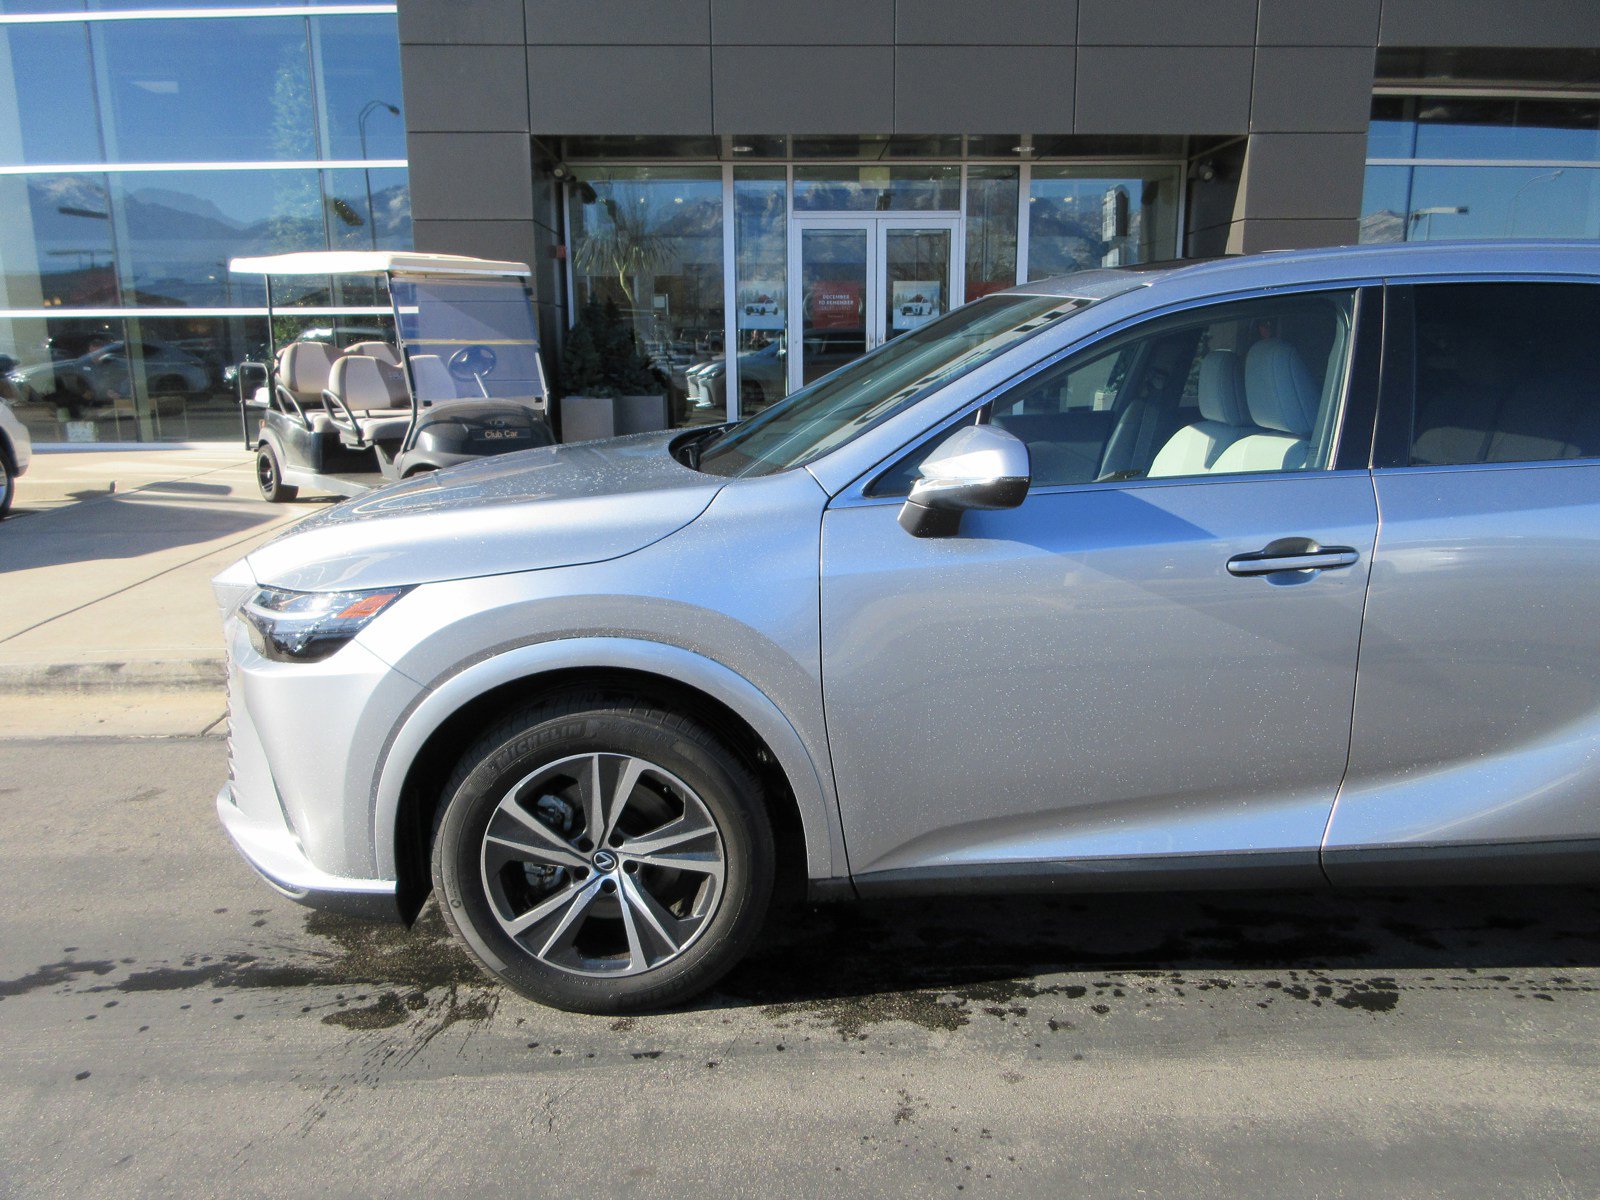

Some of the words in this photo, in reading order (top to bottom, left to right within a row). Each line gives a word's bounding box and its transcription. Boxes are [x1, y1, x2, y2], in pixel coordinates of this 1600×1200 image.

[484, 430, 503, 439] Club
[504, 430, 518, 438] Car
[496, 723, 582, 767] MICHELIN
